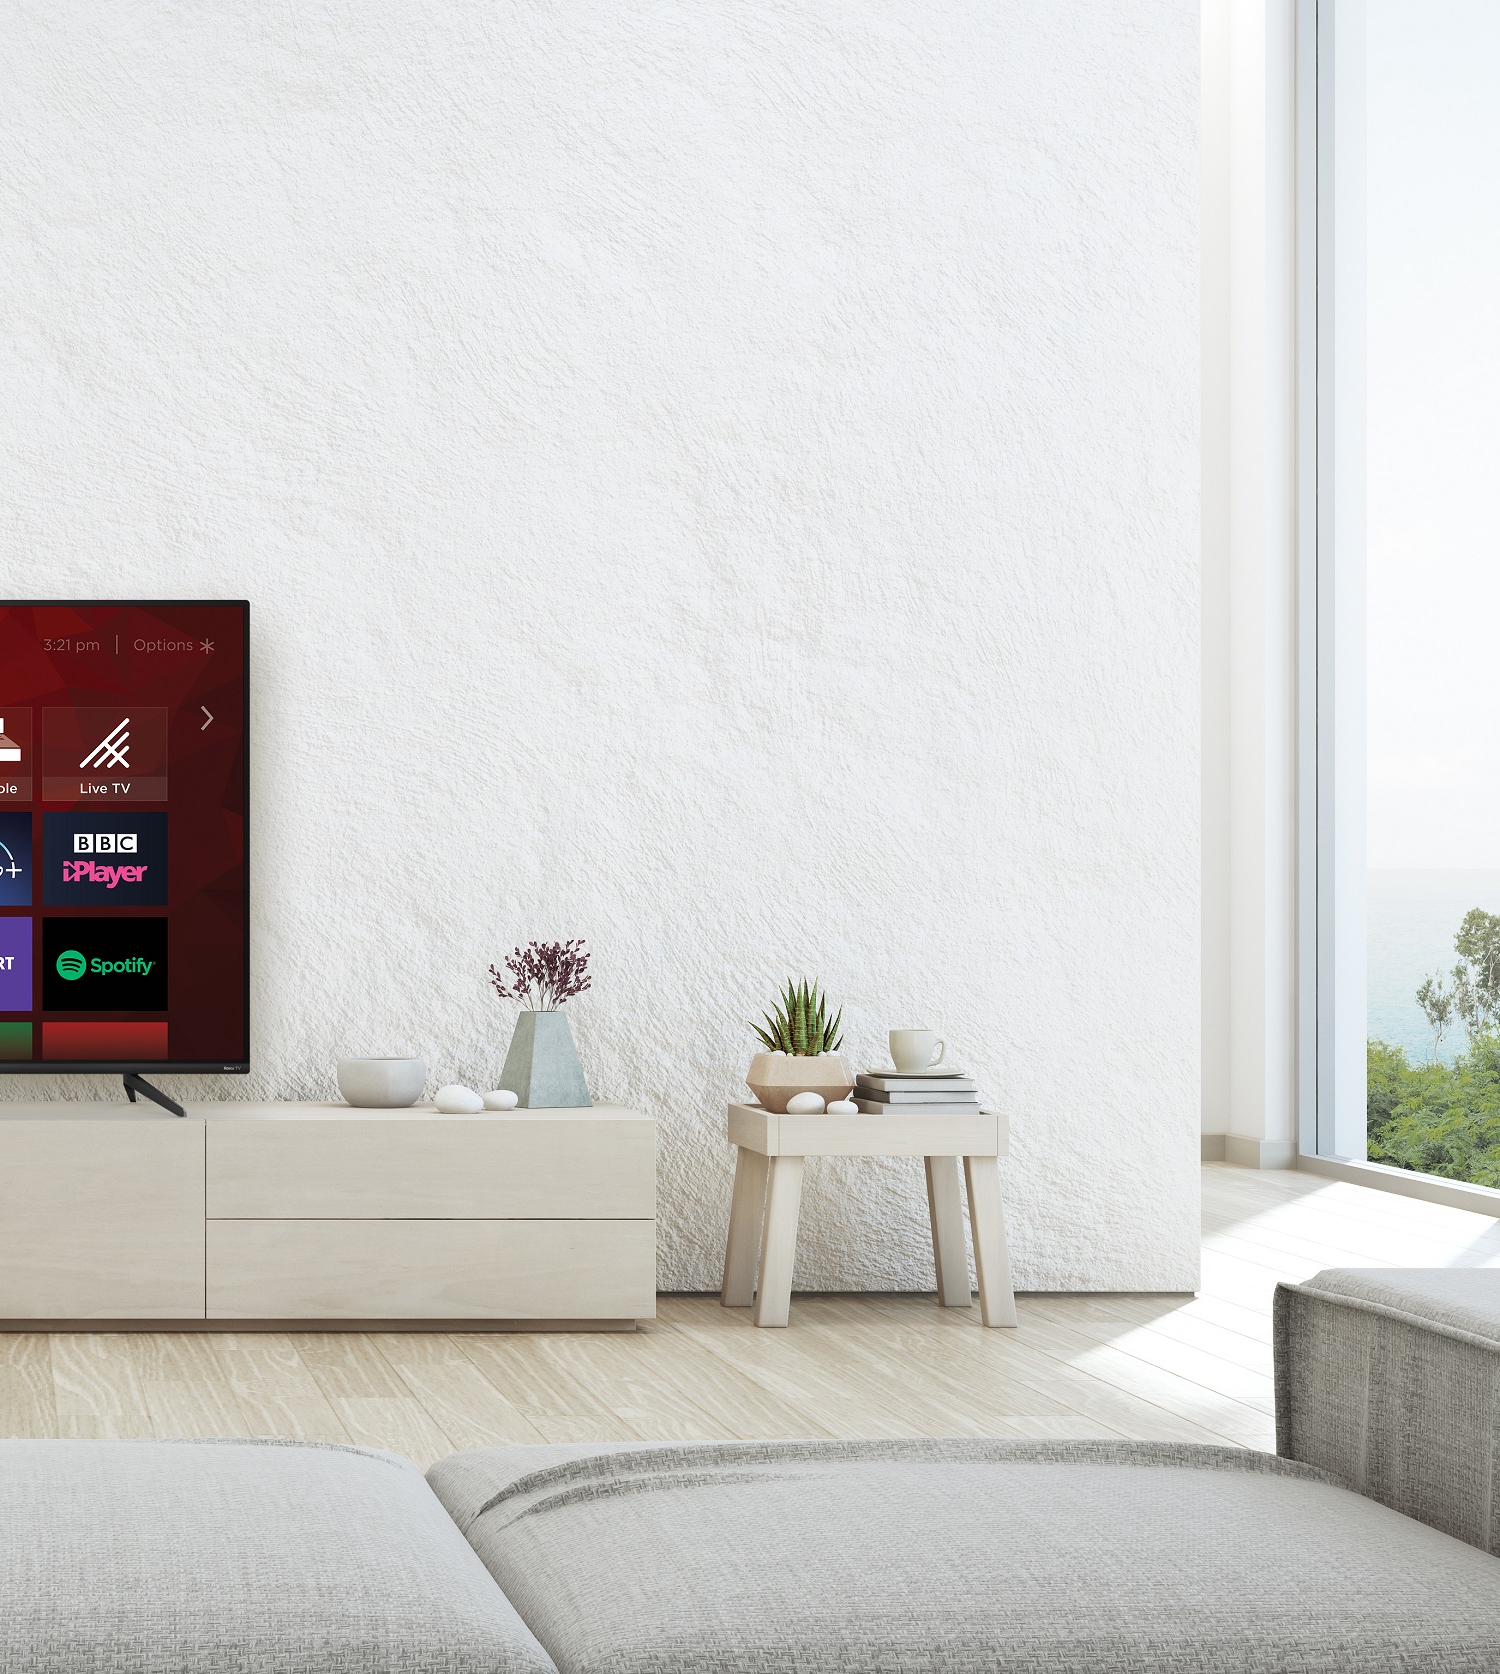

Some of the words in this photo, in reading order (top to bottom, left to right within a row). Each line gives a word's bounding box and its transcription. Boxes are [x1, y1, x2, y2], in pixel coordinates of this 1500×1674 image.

[43, 638, 72, 651] 3:21
[76, 641, 101, 654] pm
[133, 638, 194, 654] Options
[80, 782, 108, 794] Live
[111, 783, 131, 794] TV
[76, 835, 136, 853] BBC
[62, 860, 149, 889] iPlayer
[90, 956, 153, 976] Spotify
